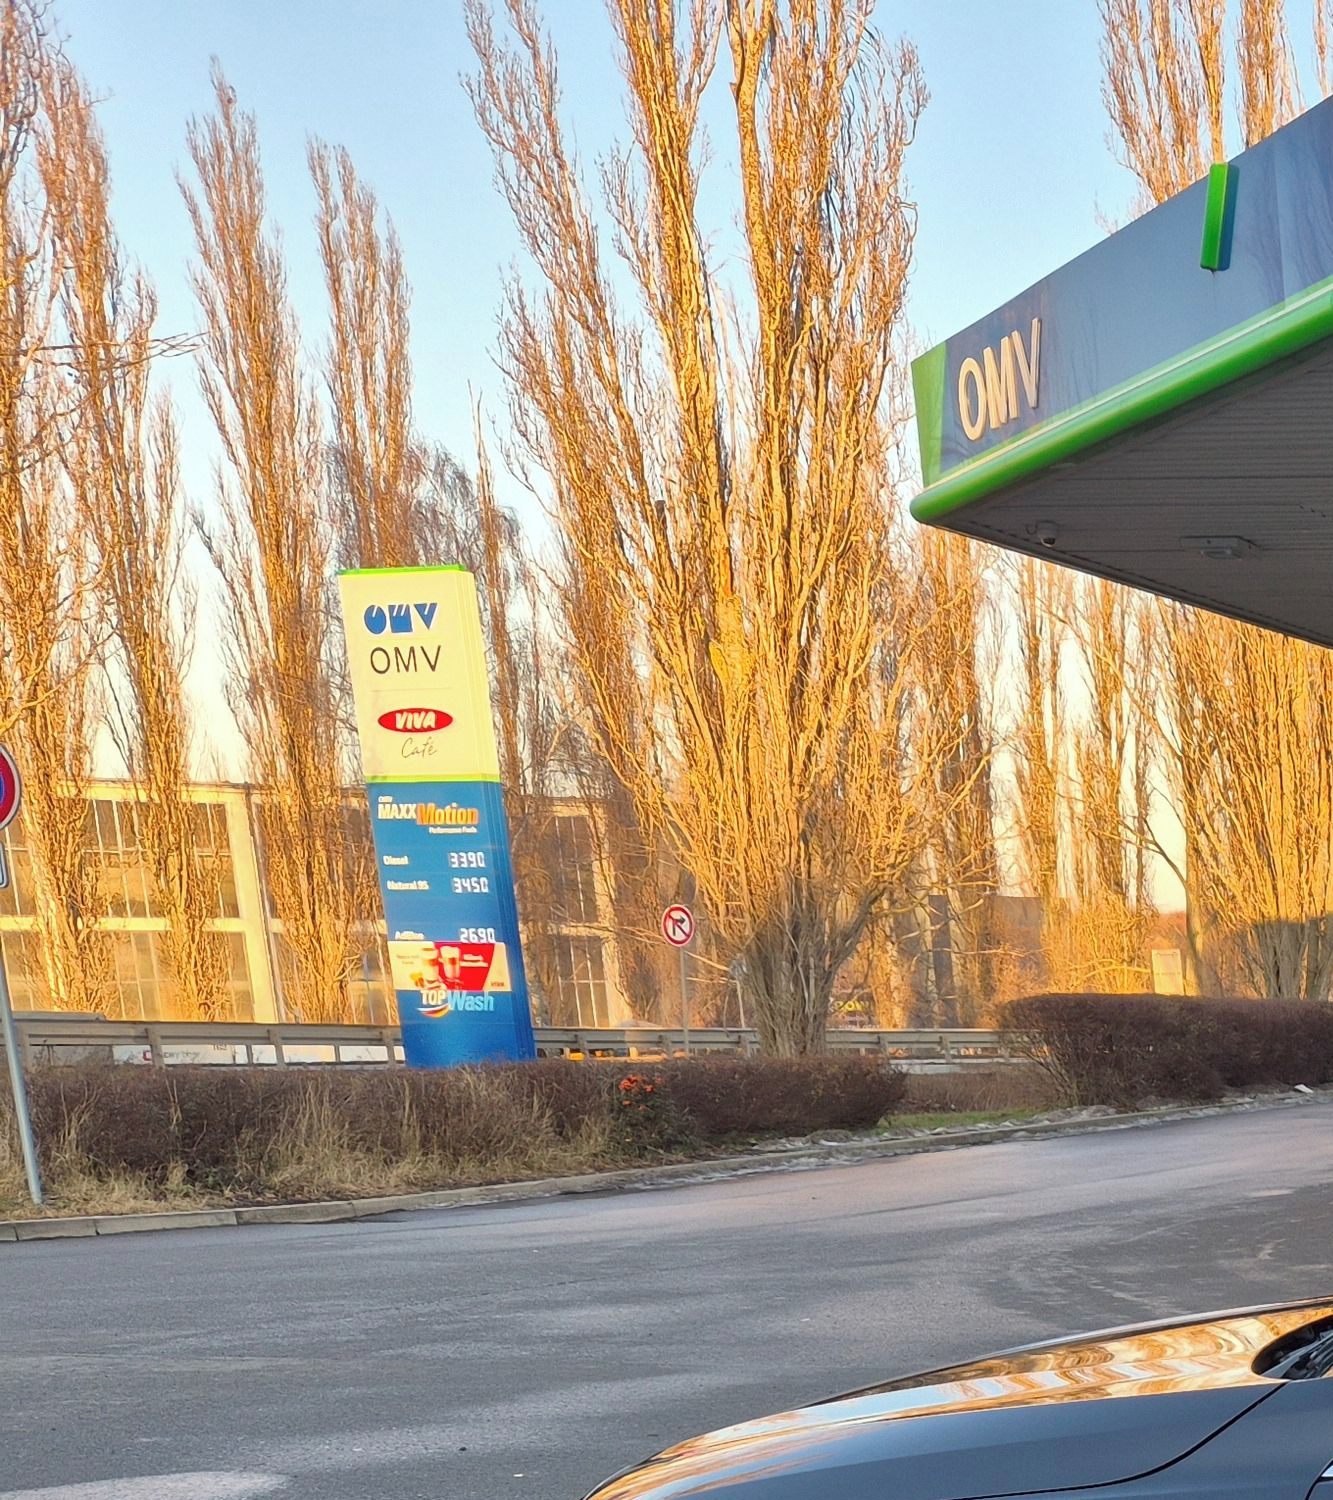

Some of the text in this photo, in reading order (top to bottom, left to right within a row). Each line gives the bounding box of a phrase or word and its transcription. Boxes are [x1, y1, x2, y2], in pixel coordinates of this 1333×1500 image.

[958, 317, 1042, 441] OMV
[370, 645, 442, 675] OMV
[394, 711, 437, 730] VIVA
